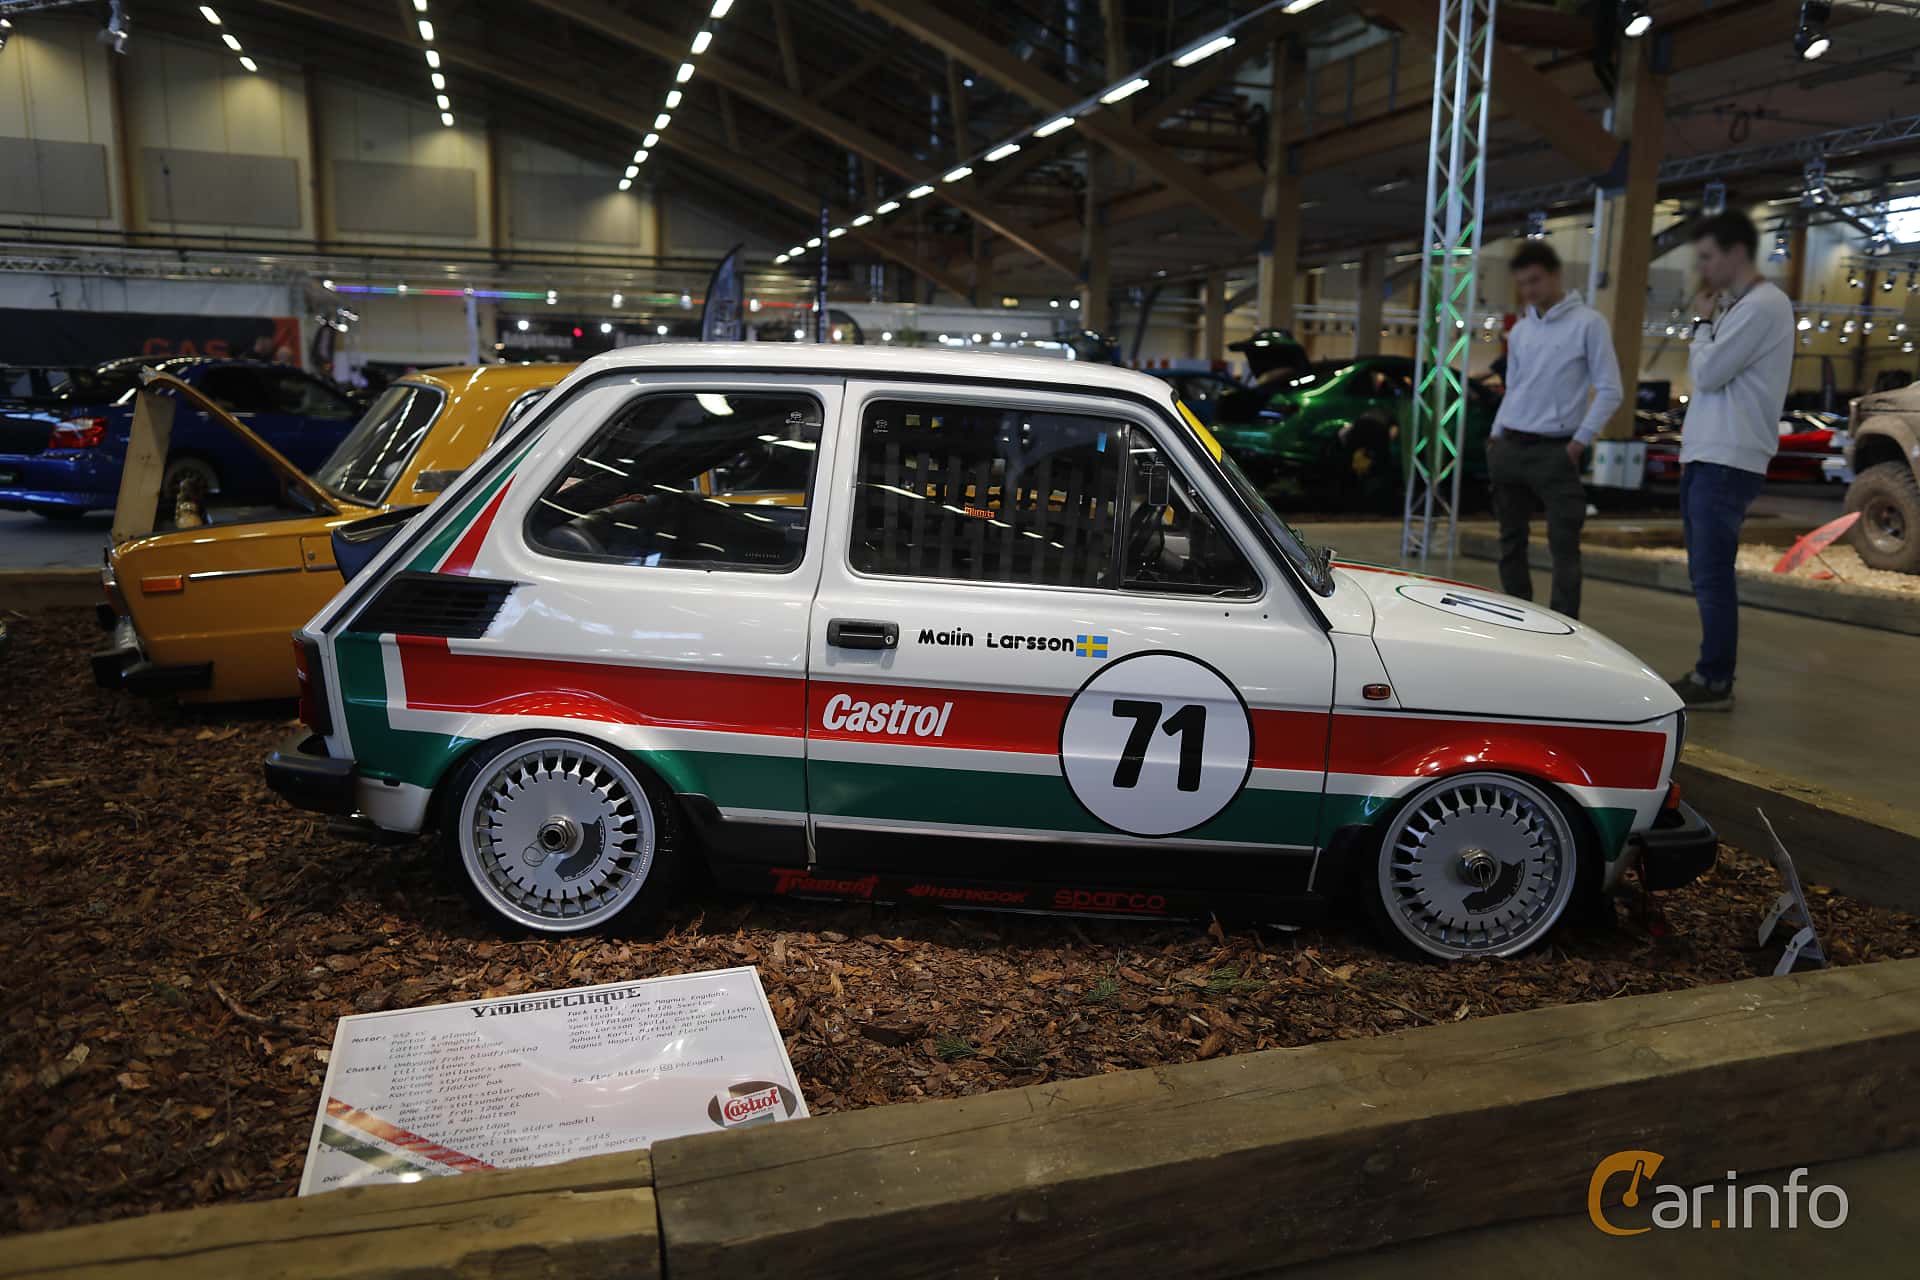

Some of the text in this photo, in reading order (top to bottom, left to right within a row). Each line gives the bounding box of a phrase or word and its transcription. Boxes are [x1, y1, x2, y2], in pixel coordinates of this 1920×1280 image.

[986, 631, 1075, 652] Larsson
[822, 693, 954, 738] Castrol
[1112, 699, 1208, 792] 71
[725, 1089, 779, 1120] Castrol
